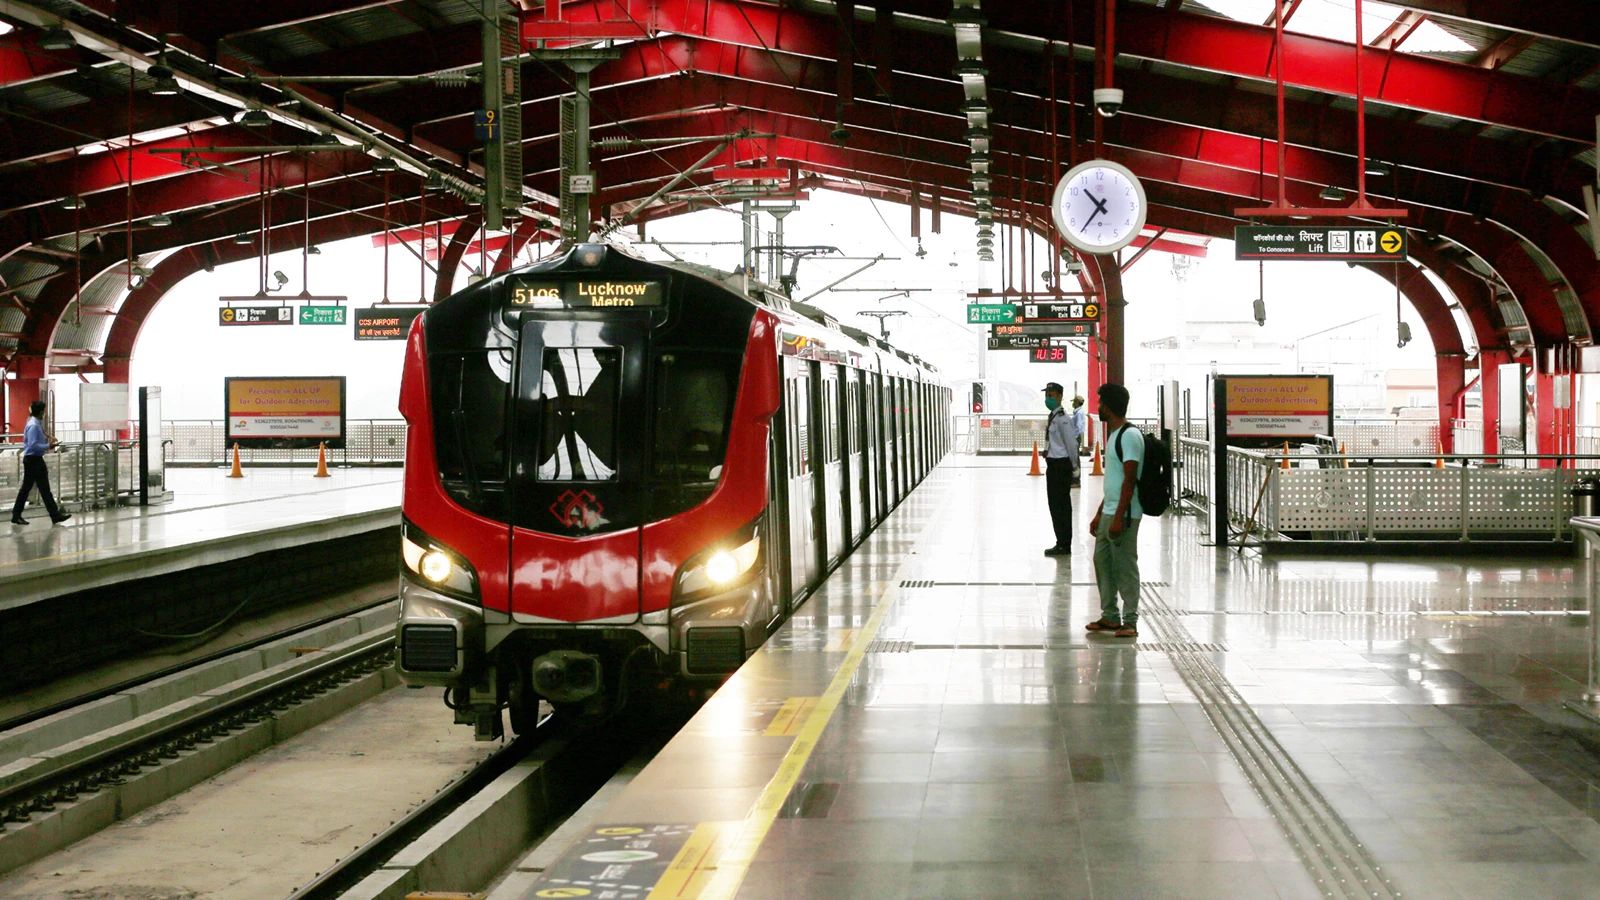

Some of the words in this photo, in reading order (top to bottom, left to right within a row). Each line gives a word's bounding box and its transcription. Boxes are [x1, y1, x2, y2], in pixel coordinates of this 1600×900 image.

[486, 110, 495, 123] 9
[1081, 176, 1088, 184] 11
[1095, 172, 1104, 180] 12
[1070, 187, 1078, 196] 10
[1125, 187, 1130, 196] 2
[1065, 202, 1071, 210] 9
[1129, 202, 1135, 211] 3
[1070, 218, 1076, 226] 8
[1125, 218, 1130, 226] 4
[1113, 229, 1118, 237] 5
[1299, 230, 1324, 241] लिफ्ट
[1308, 243, 1324, 253] Lift
[579, 282, 647, 296] Lucknow
[592, 296, 634, 307] Metro
[359, 318, 372, 326] CCS
[372, 318, 400, 326] AIRPORT
[309, 386, 321, 394] UP
[1233, 385, 1267, 393] Presence
[255, 397, 286, 405] Outdoor
[288, 397, 331, 406] Advertising
[1240, 396, 1272, 404] Outdoor
[1274, 396, 1318, 405] Advertising
